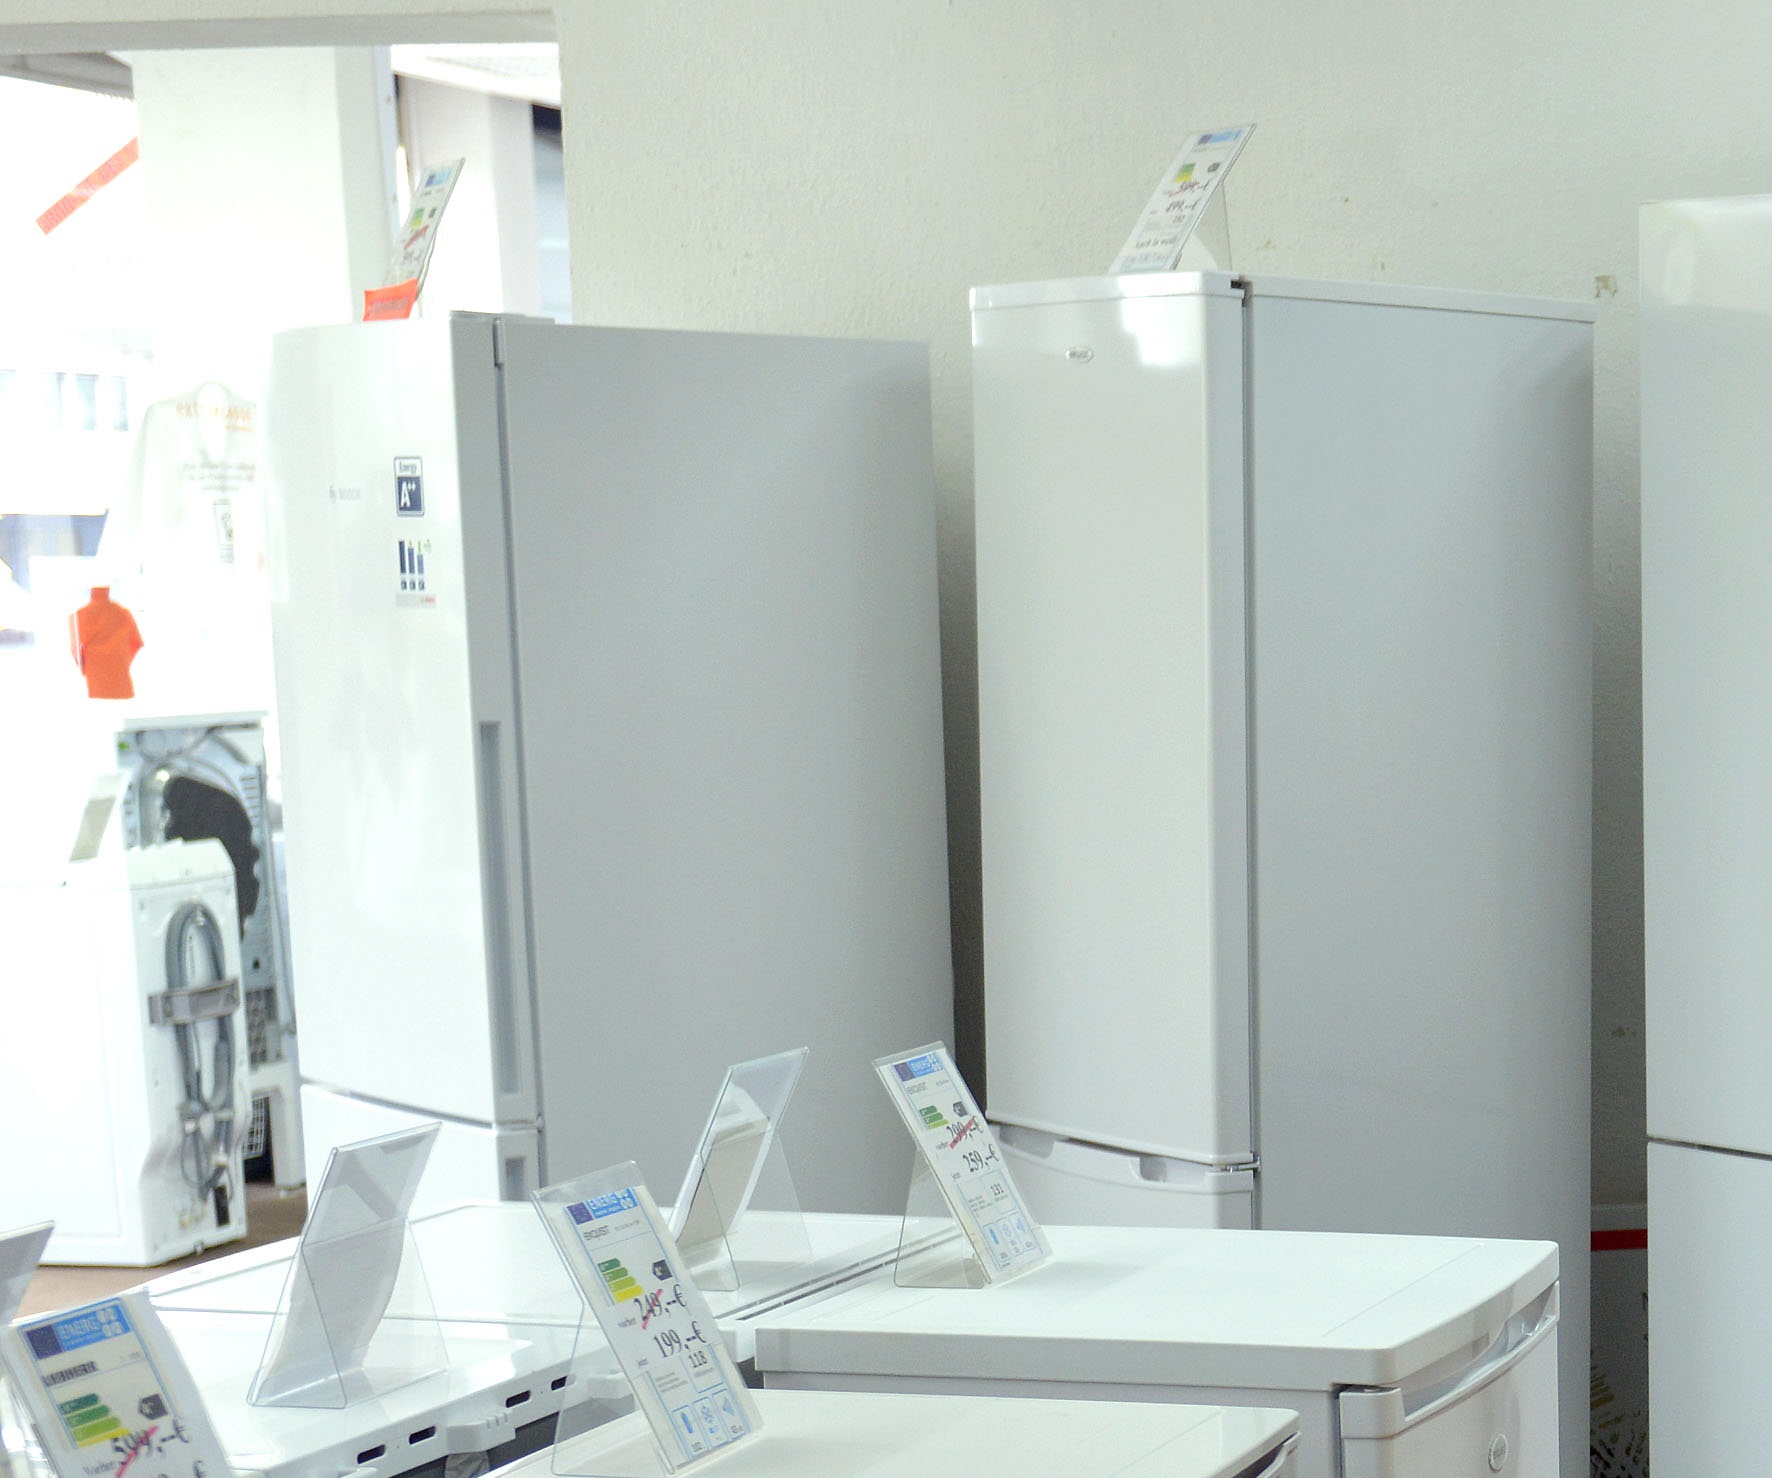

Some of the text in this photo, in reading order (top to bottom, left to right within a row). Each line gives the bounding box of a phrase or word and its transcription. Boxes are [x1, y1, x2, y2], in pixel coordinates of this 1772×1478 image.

[963, 1144, 1000, 1173] 259,--€
[653, 1321, 706, 1358] 199,--€
[688, 1350, 707, 1368] 118
